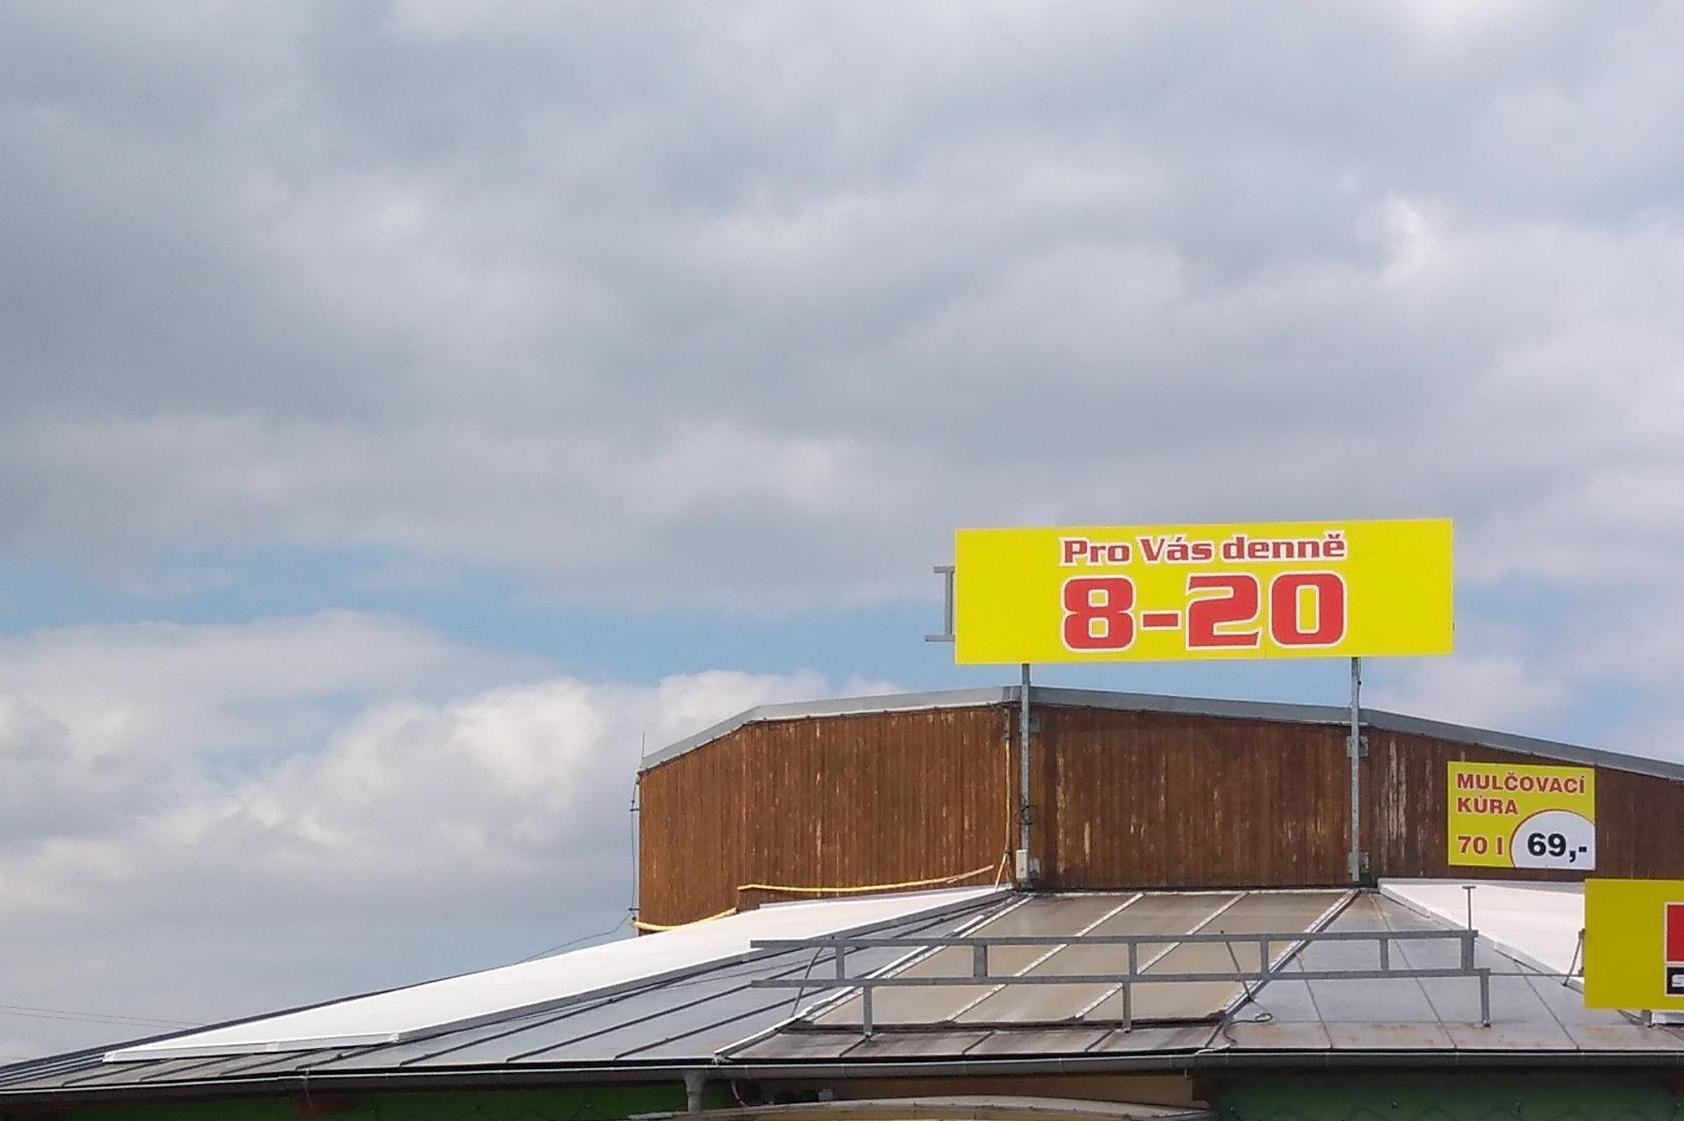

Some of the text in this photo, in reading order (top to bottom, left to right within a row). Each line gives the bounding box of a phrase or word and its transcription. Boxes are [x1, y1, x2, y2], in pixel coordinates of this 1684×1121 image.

[1064, 533, 1345, 563] Pro Vás denně
[1063, 572, 1345, 649] 8-20
[1457, 772, 1586, 794] MULČOVACÍ
[1457, 835, 1488, 855] 70
[1527, 832, 1587, 863] 69,-
